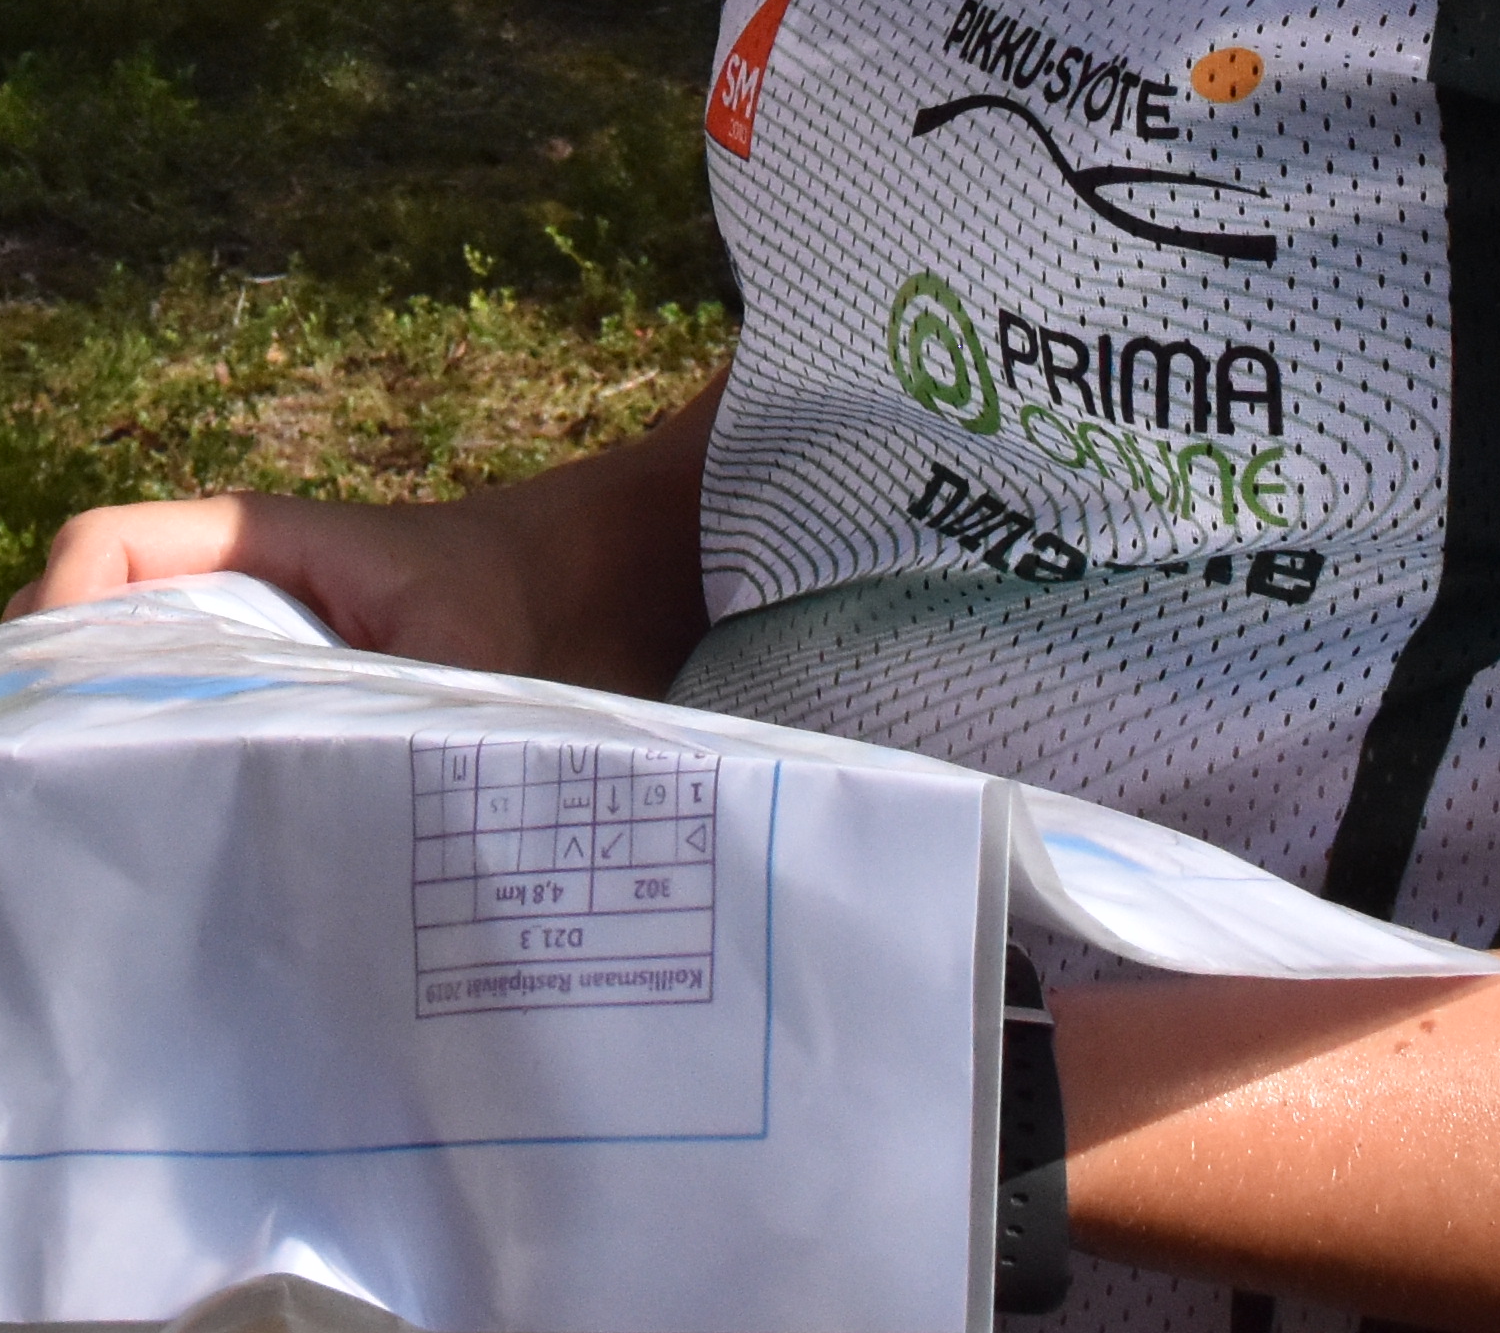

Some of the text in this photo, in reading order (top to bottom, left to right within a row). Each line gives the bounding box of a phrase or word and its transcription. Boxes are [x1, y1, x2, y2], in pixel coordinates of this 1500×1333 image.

[999, 308, 1284, 435] PRIMA
[907, 462, 1325, 605] nonae
[643, 785, 666, 806] 67
[496, 879, 670, 905] 302 4,8 km
[579, 967, 703, 990] Koillismaan
[425, 981, 461, 1003] 2019
